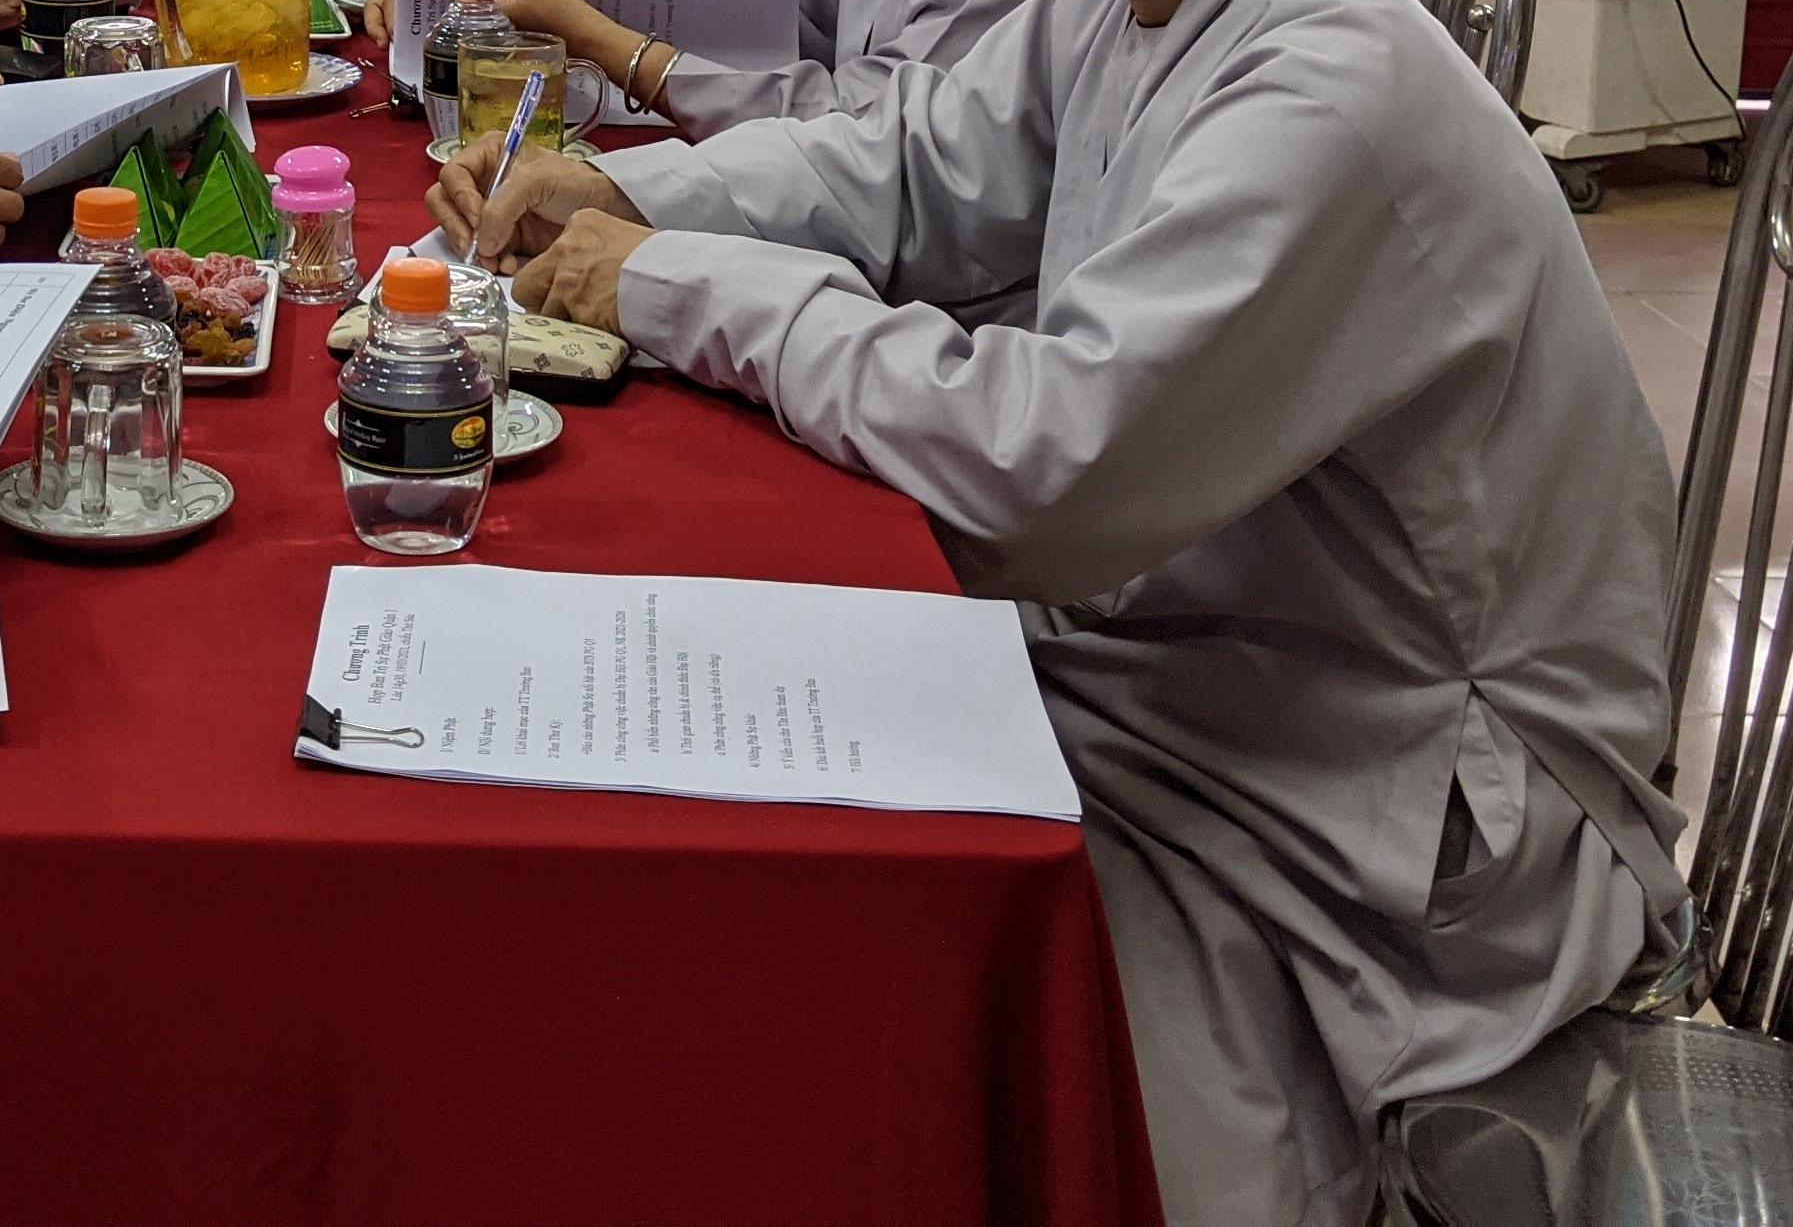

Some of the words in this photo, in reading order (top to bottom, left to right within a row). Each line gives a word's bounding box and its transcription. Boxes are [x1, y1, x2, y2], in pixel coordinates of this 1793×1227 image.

[381, 613, 396, 627] Quận
[349, 624, 370, 645] Trình
[380, 629, 392, 642] Giáo
[376, 643, 392, 655] Phật
[342, 649, 370, 681] Chương
[371, 676, 386, 687] Ban
[368, 691, 386, 703] Họp
[443, 717, 456, 730] Phật
[482, 721, 496, 735] dung
[442, 731, 456, 747] Niệm
